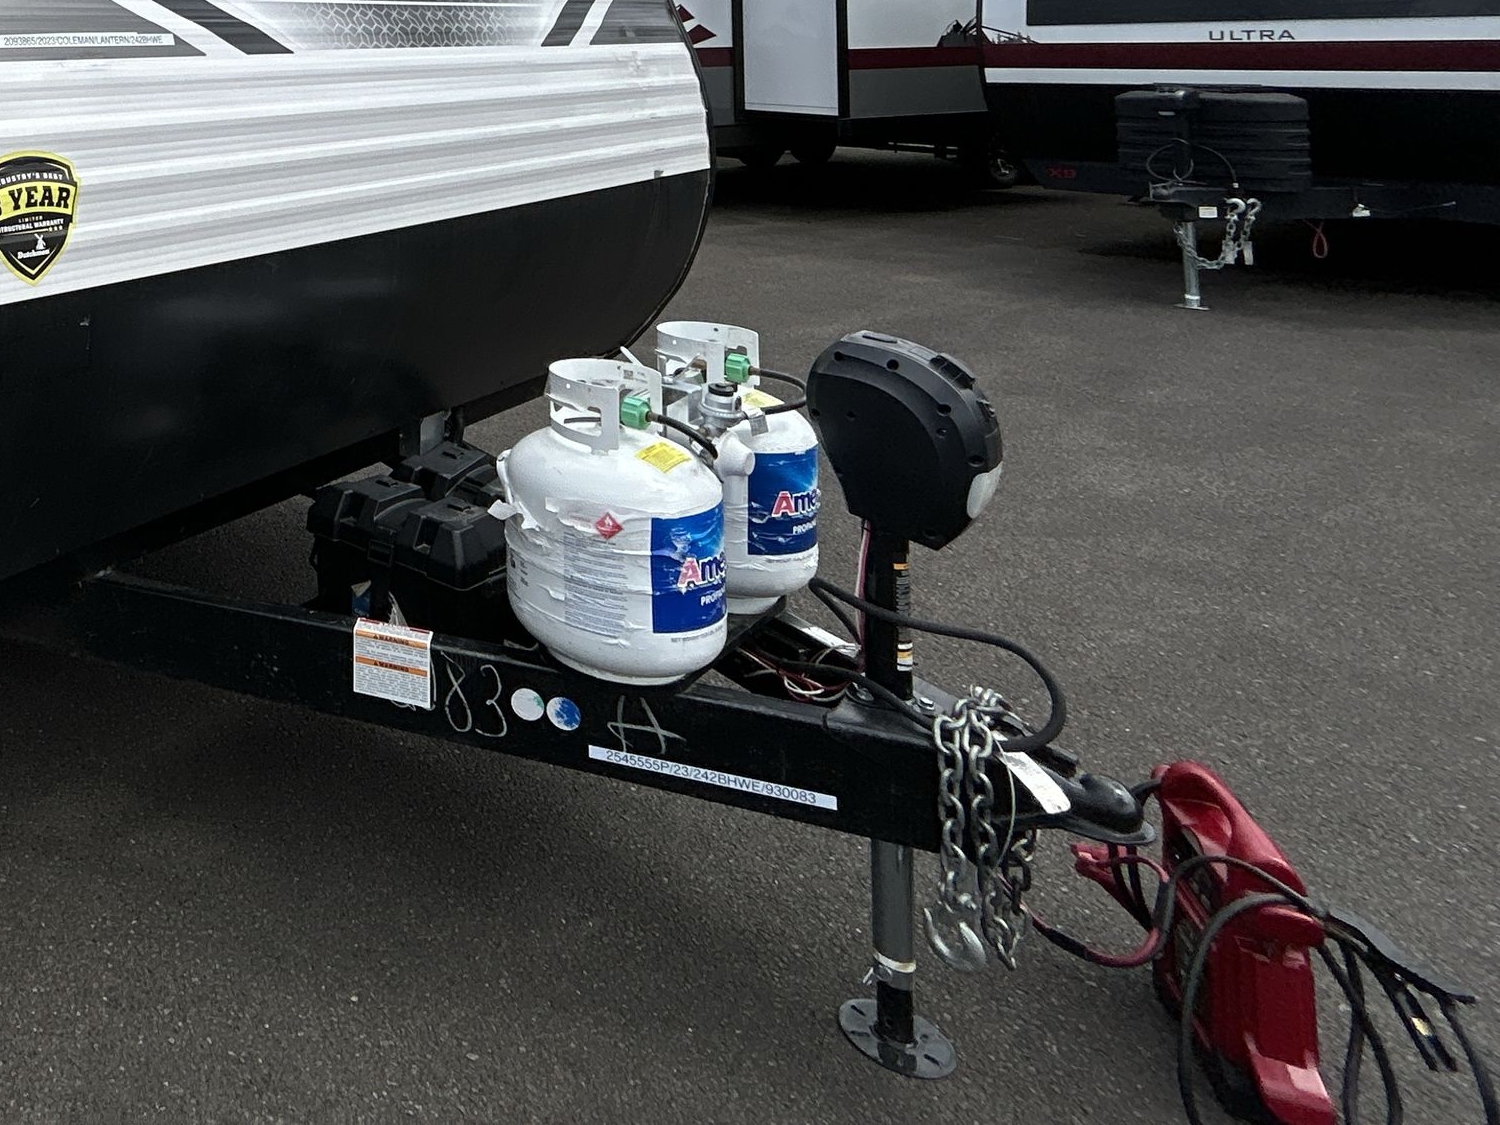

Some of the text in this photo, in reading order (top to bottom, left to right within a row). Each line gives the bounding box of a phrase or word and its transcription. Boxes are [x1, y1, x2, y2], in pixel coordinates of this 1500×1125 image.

[1208, 29, 1296, 41] ULTRA
[8, 185, 71, 211] YEAR
[380, 635, 410, 646] WARNING
[379, 661, 410, 673] WARNING
[606, 750, 817, 805] 2545555P/23/242BHWE/930083
